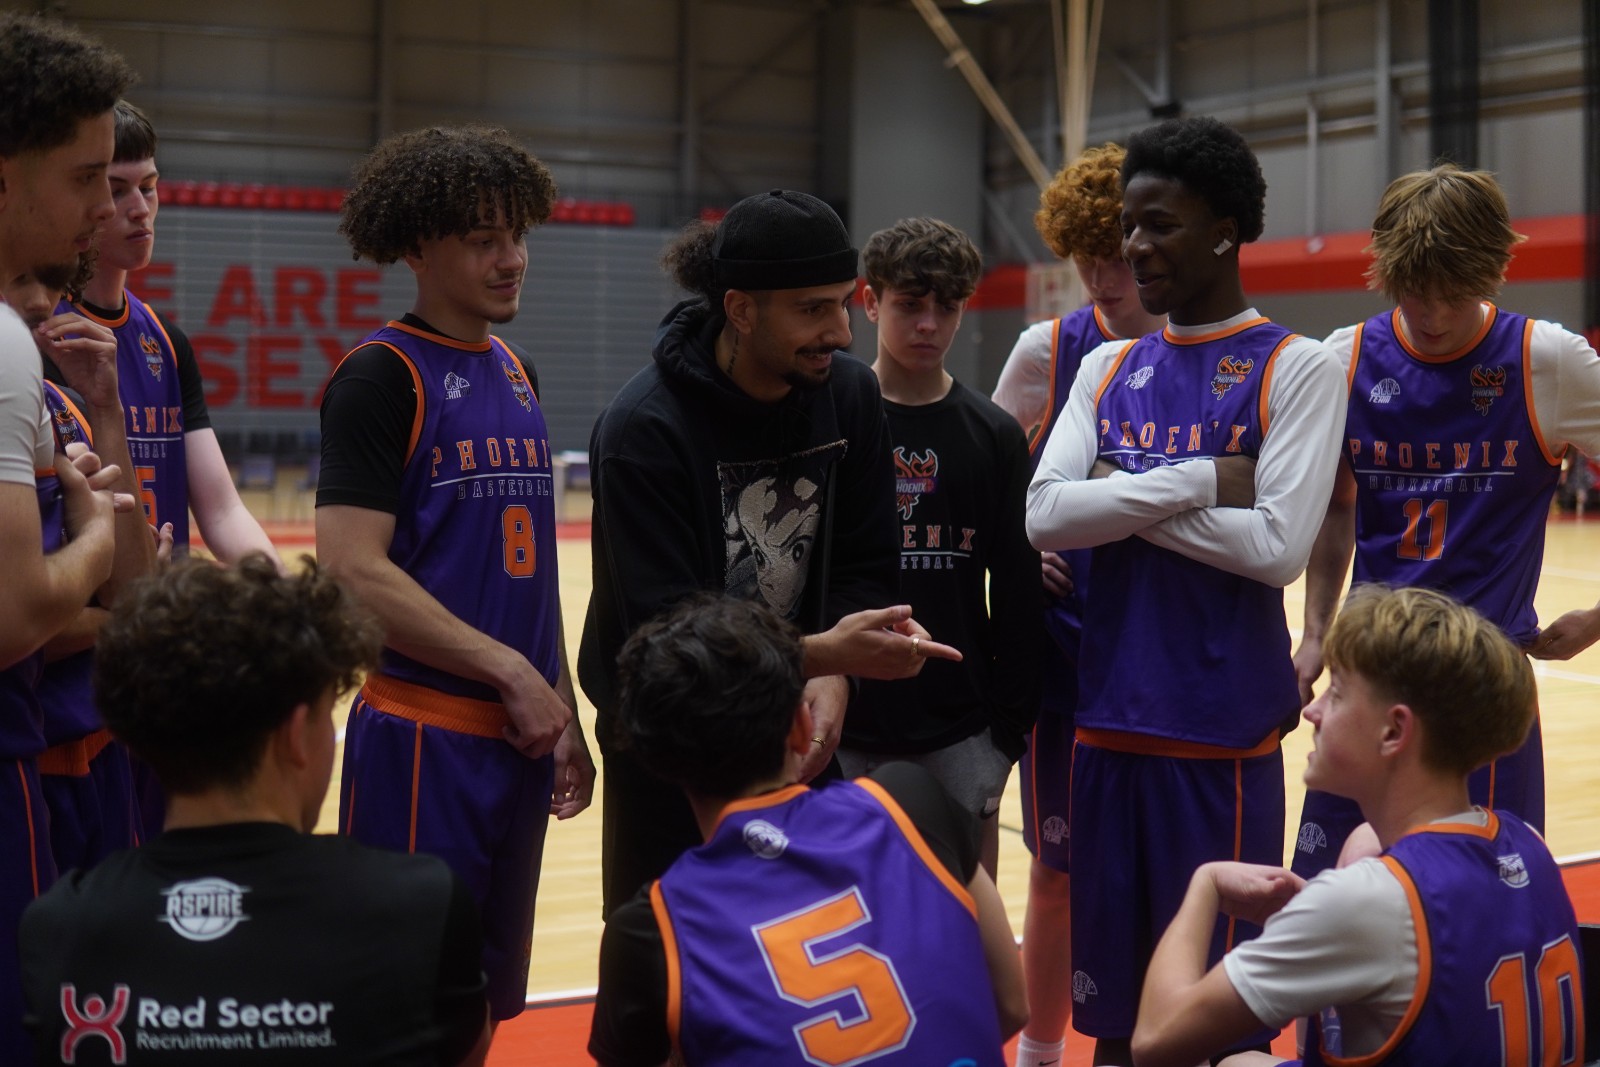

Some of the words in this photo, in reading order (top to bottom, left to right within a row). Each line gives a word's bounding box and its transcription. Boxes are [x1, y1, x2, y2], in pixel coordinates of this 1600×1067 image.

[206, 264, 384, 330] ARE
[188, 332, 360, 410] SEX
[129, 405, 183, 434] ENIX
[1099, 418, 1247, 454] PHOENX
[431, 437, 551, 478] PHOENI
[1349, 438, 1519, 471] PHOENIX
[896, 482, 927, 494] HOENIX
[1369, 475, 1494, 493] BASKETBALL
[501, 504, 537, 579] 8
[1396, 497, 1449, 562] 11
[900, 556, 954, 570] ETBAL
[166, 893, 244, 918] ASPIRE
[751, 884, 917, 1067] 5
[137, 996, 207, 1029] Red
[217, 998, 334, 1029] Sector
[1485, 932, 1586, 1067] 10
[135, 1028, 254, 1051] Recruitment
